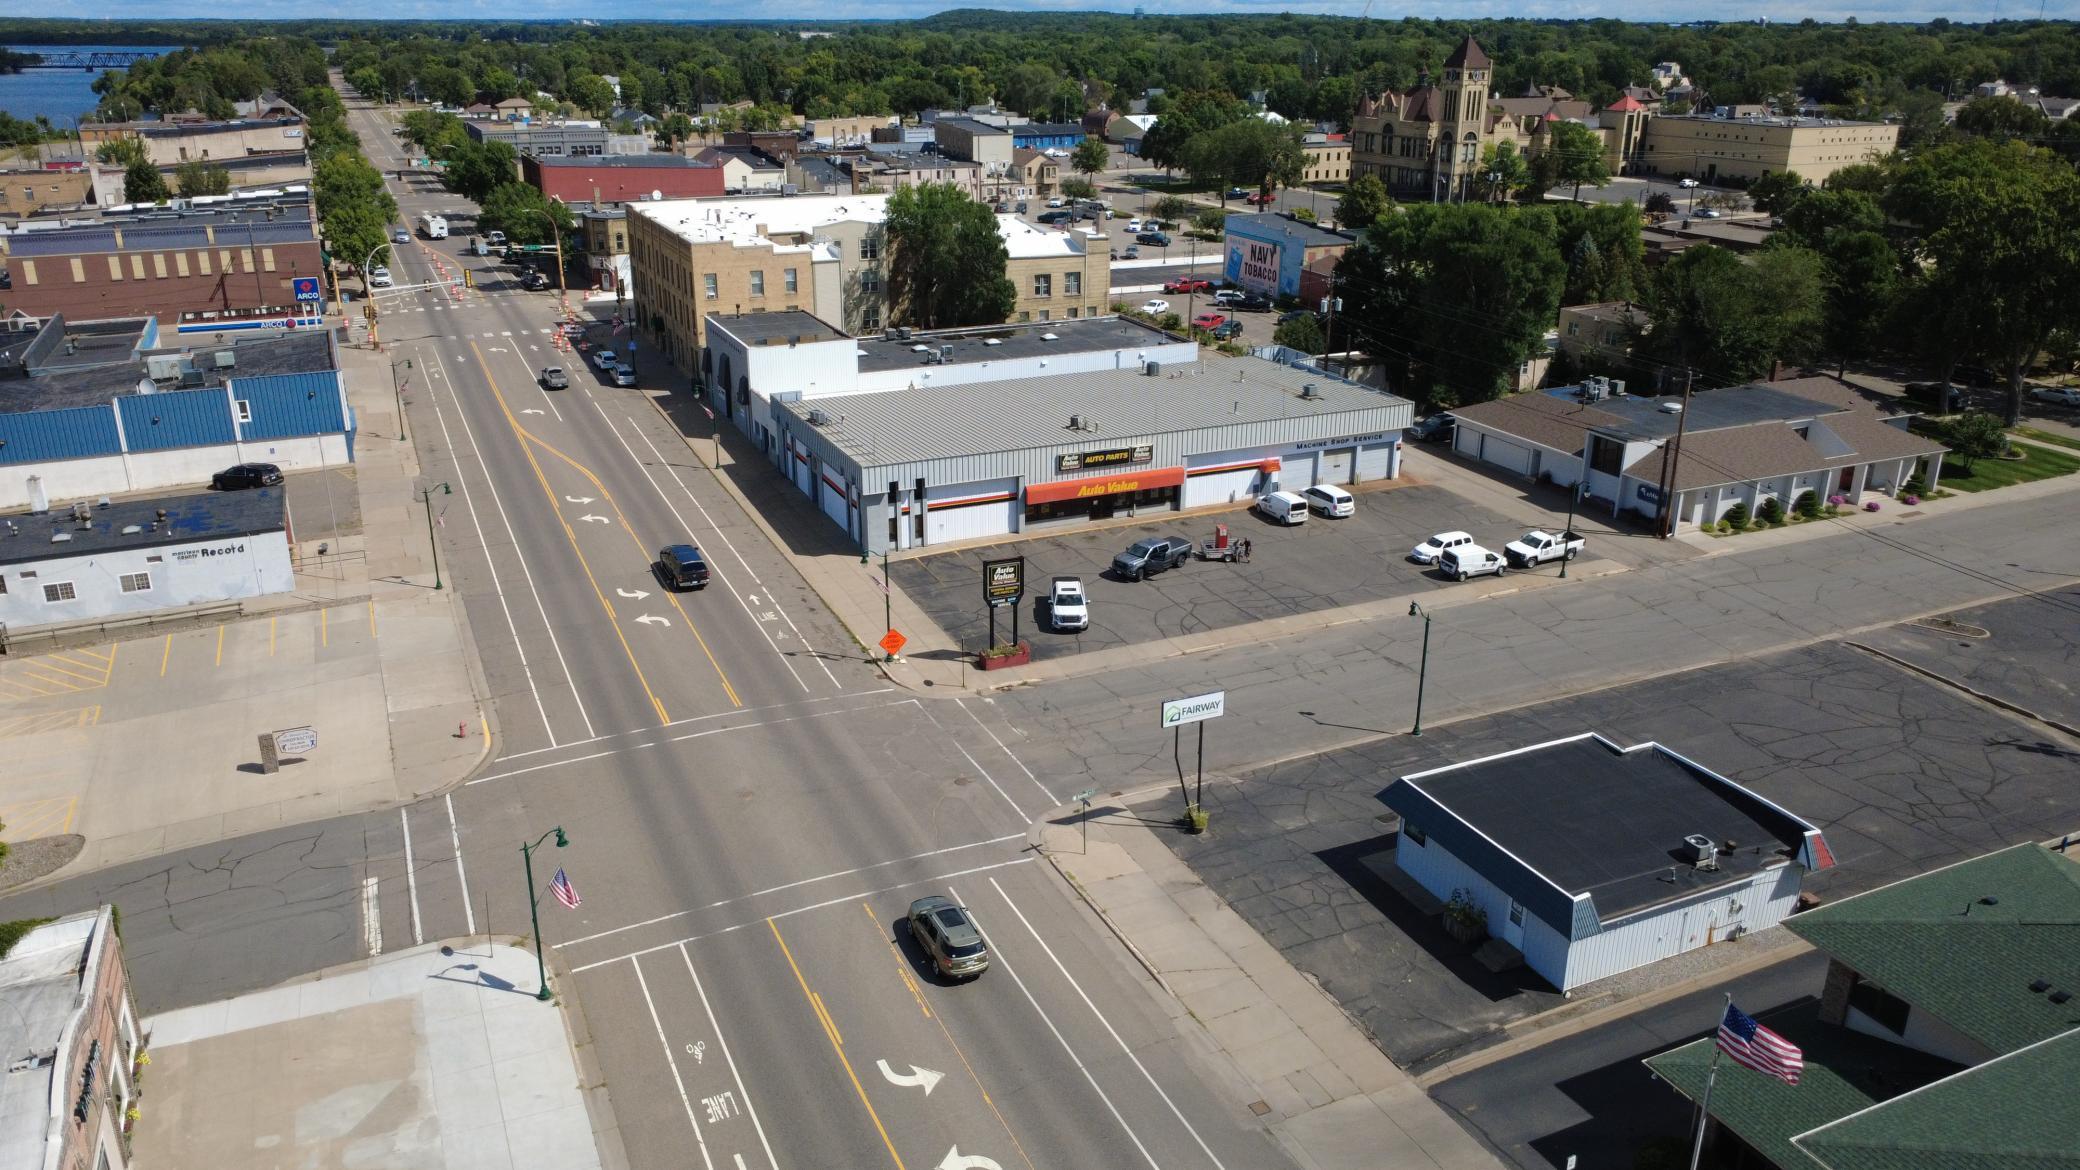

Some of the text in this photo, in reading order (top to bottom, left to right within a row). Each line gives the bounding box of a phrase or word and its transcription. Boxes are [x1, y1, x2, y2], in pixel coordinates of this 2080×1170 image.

[1250, 243, 1277, 266] NAVY
[1244, 262, 1277, 283] TOBACCO
[297, 292, 319, 300] ARCO
[260, 321, 283, 329] ARCO
[1084, 455, 1105, 463] AUTO
[1105, 452, 1129, 461] PARTS
[1077, 481, 1139, 497] Auto Value
[201, 544, 245, 557] Record
[995, 566, 1015, 574] Auto
[993, 573, 1016, 581] Value
[1181, 700, 1221, 716] FAIRWAY
[701, 1091, 740, 1124] LANE
